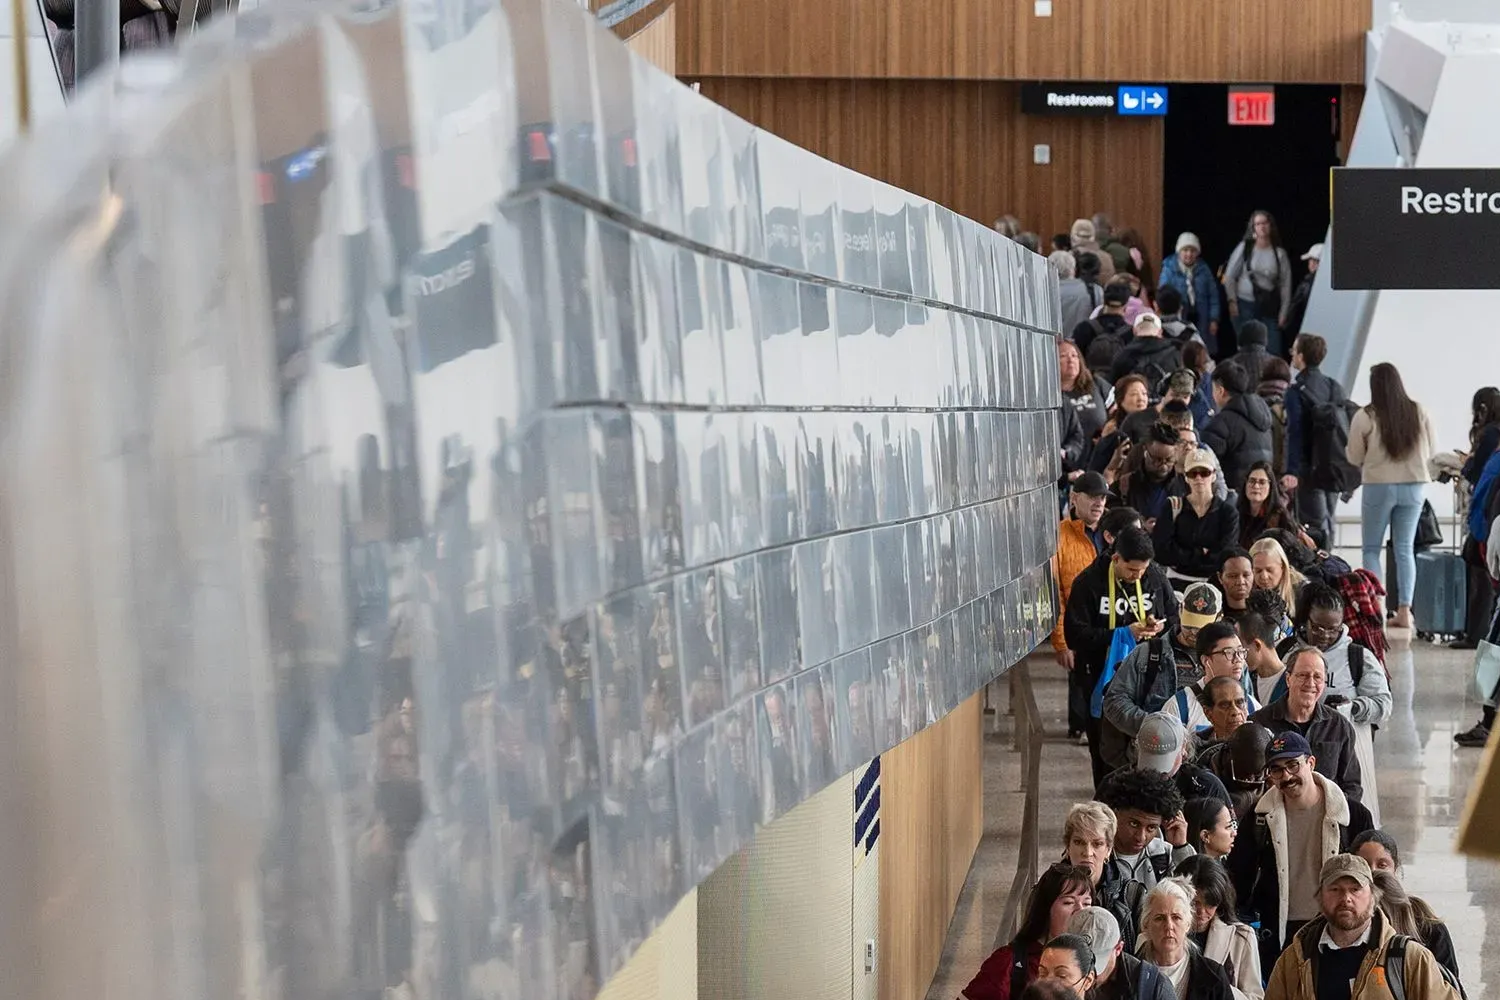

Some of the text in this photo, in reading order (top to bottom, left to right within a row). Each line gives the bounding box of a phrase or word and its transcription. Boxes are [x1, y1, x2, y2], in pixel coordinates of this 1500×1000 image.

[1047, 92, 1115, 107] Restrooms
[1236, 95, 1268, 121] EXIT
[1099, 593, 1153, 616] BOSS
